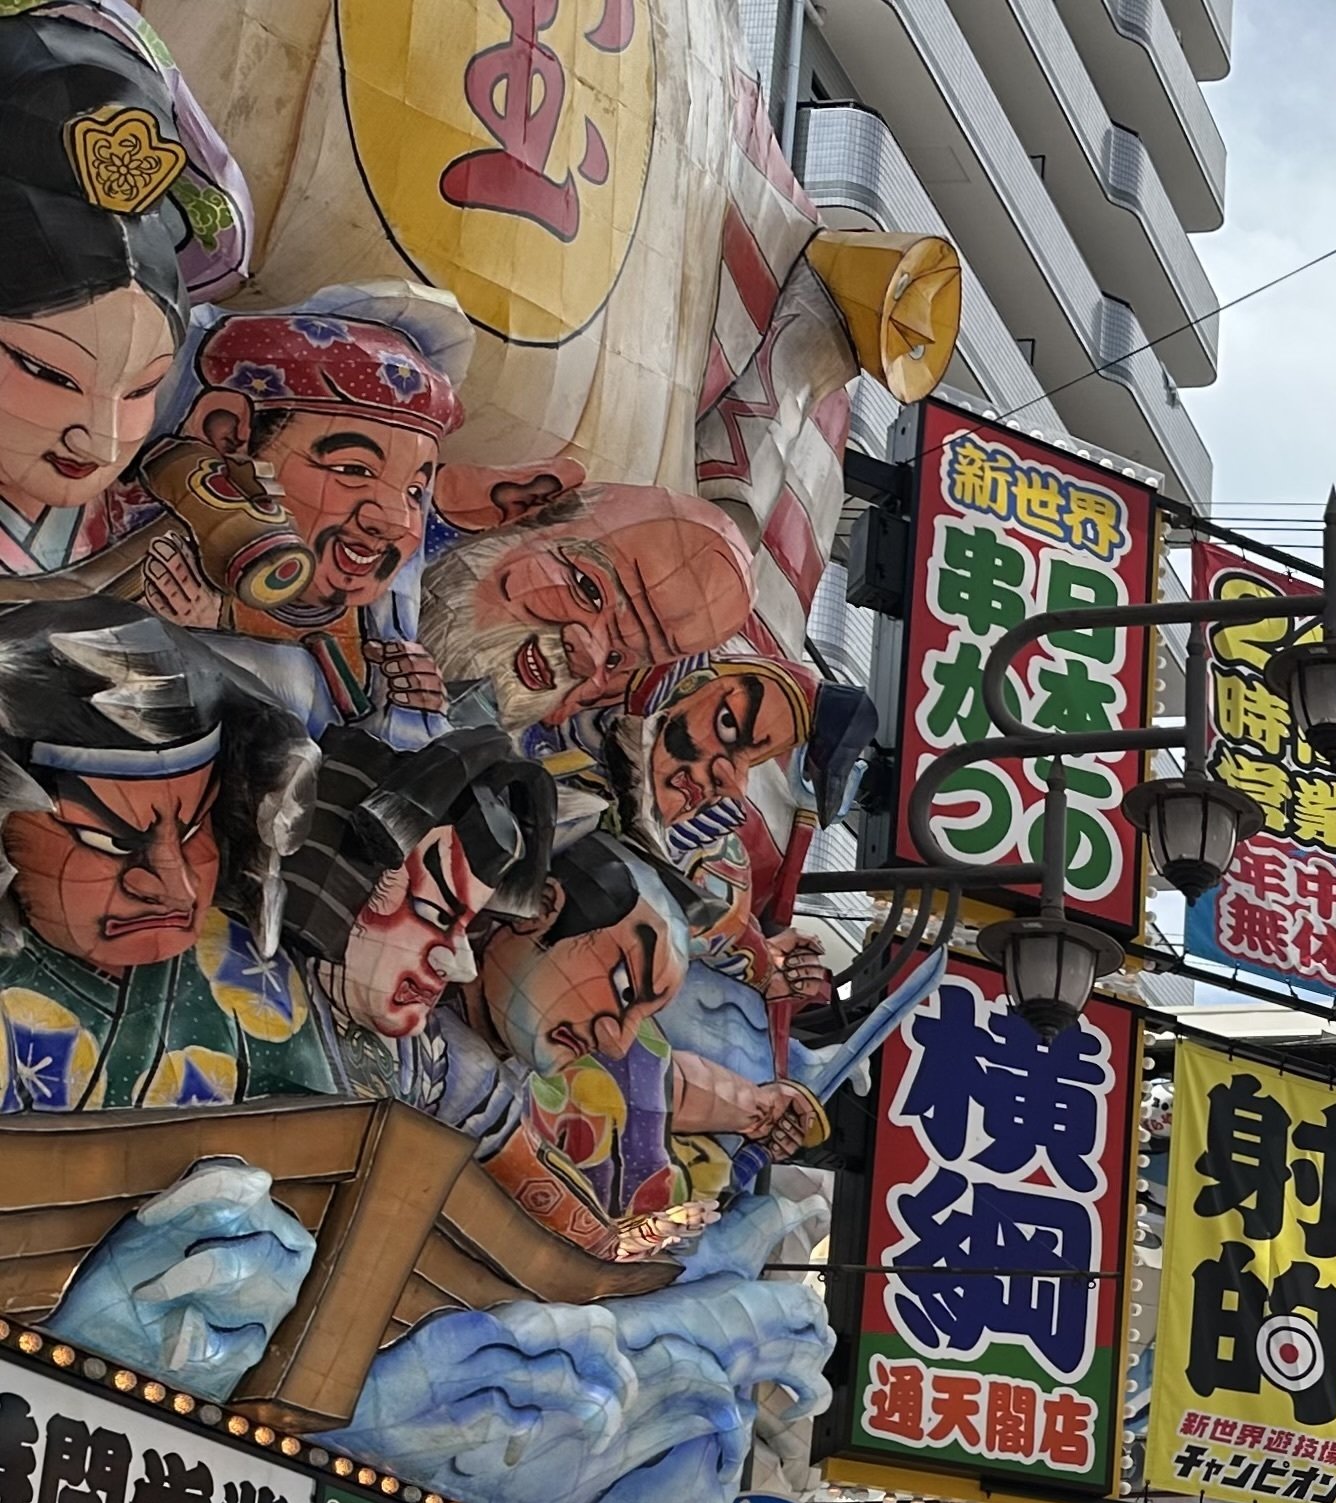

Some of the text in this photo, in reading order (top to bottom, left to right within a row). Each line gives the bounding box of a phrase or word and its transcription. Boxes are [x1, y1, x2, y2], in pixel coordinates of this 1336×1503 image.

[951, 438, 1125, 559] 新世界
[928, 524, 1026, 864] 串かつ
[892, 985, 1108, 1373] 横綱
[870, 1363, 1093, 1469] 通天閣店
